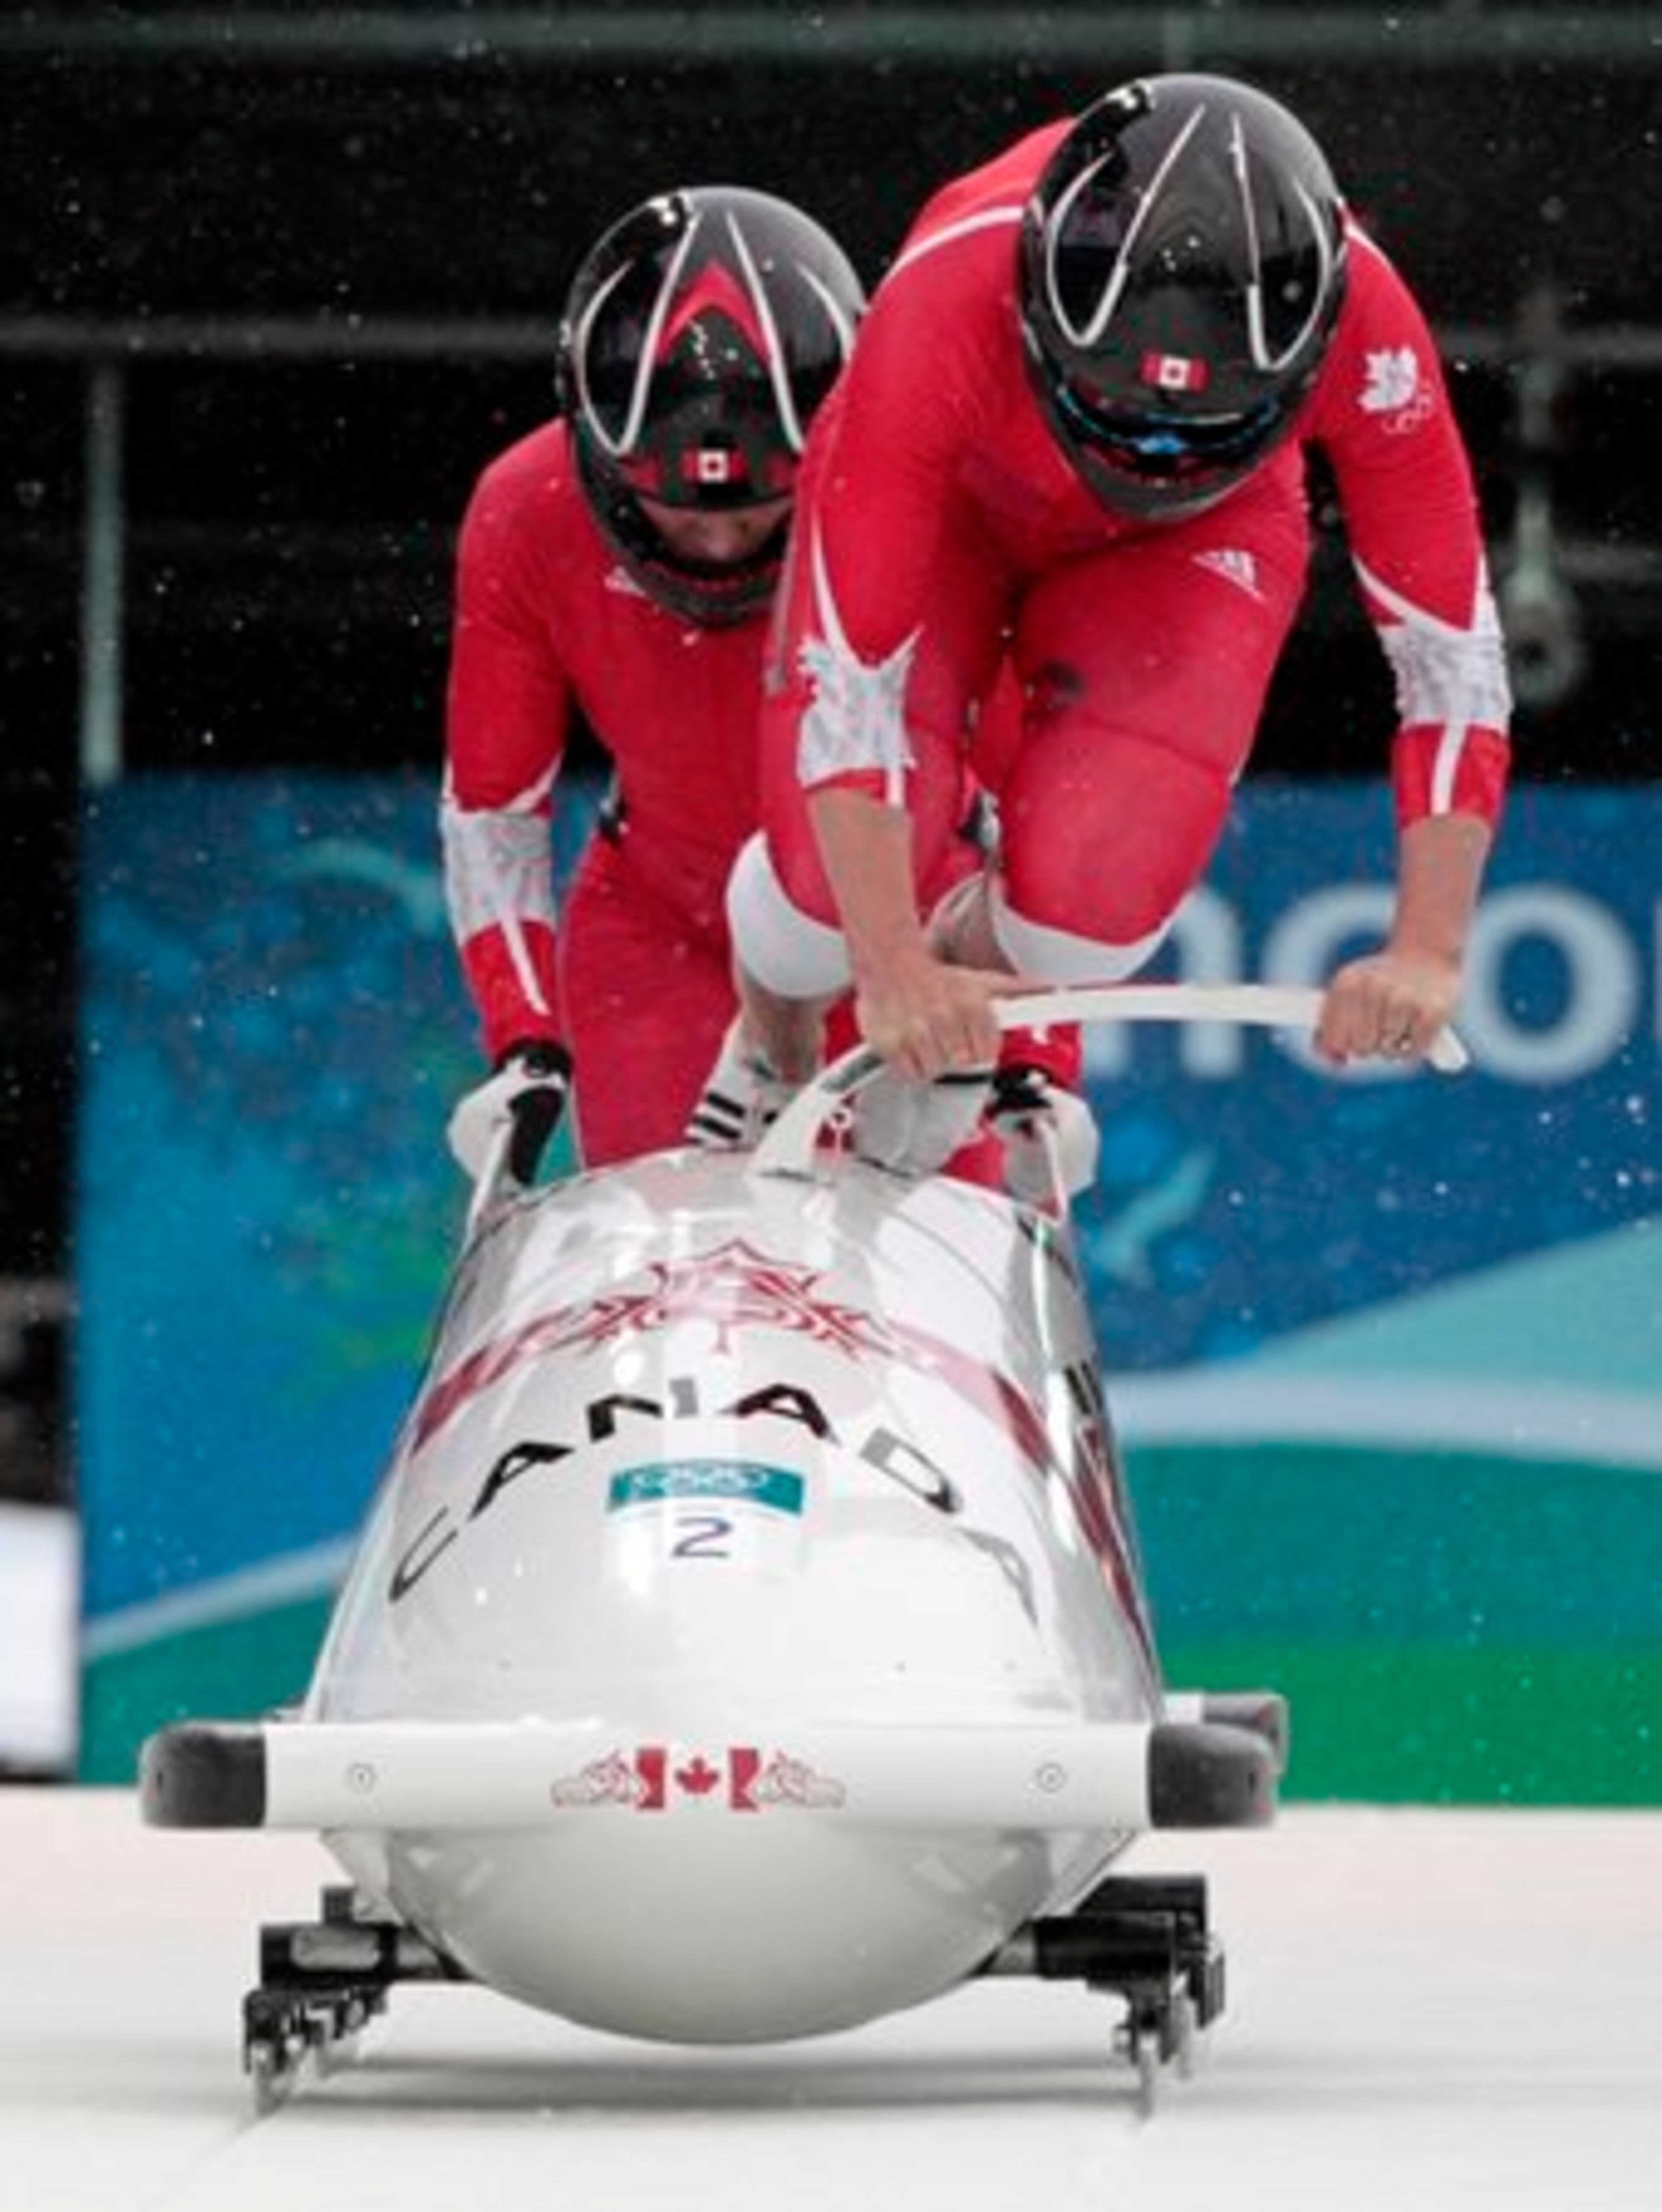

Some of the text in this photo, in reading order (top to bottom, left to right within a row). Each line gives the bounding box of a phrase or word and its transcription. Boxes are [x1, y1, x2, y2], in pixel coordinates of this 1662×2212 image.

[1084, 881, 1662, 1084] nco
[389, 1377, 1038, 1625] CANADA
[672, 1516, 732, 1559] 2
